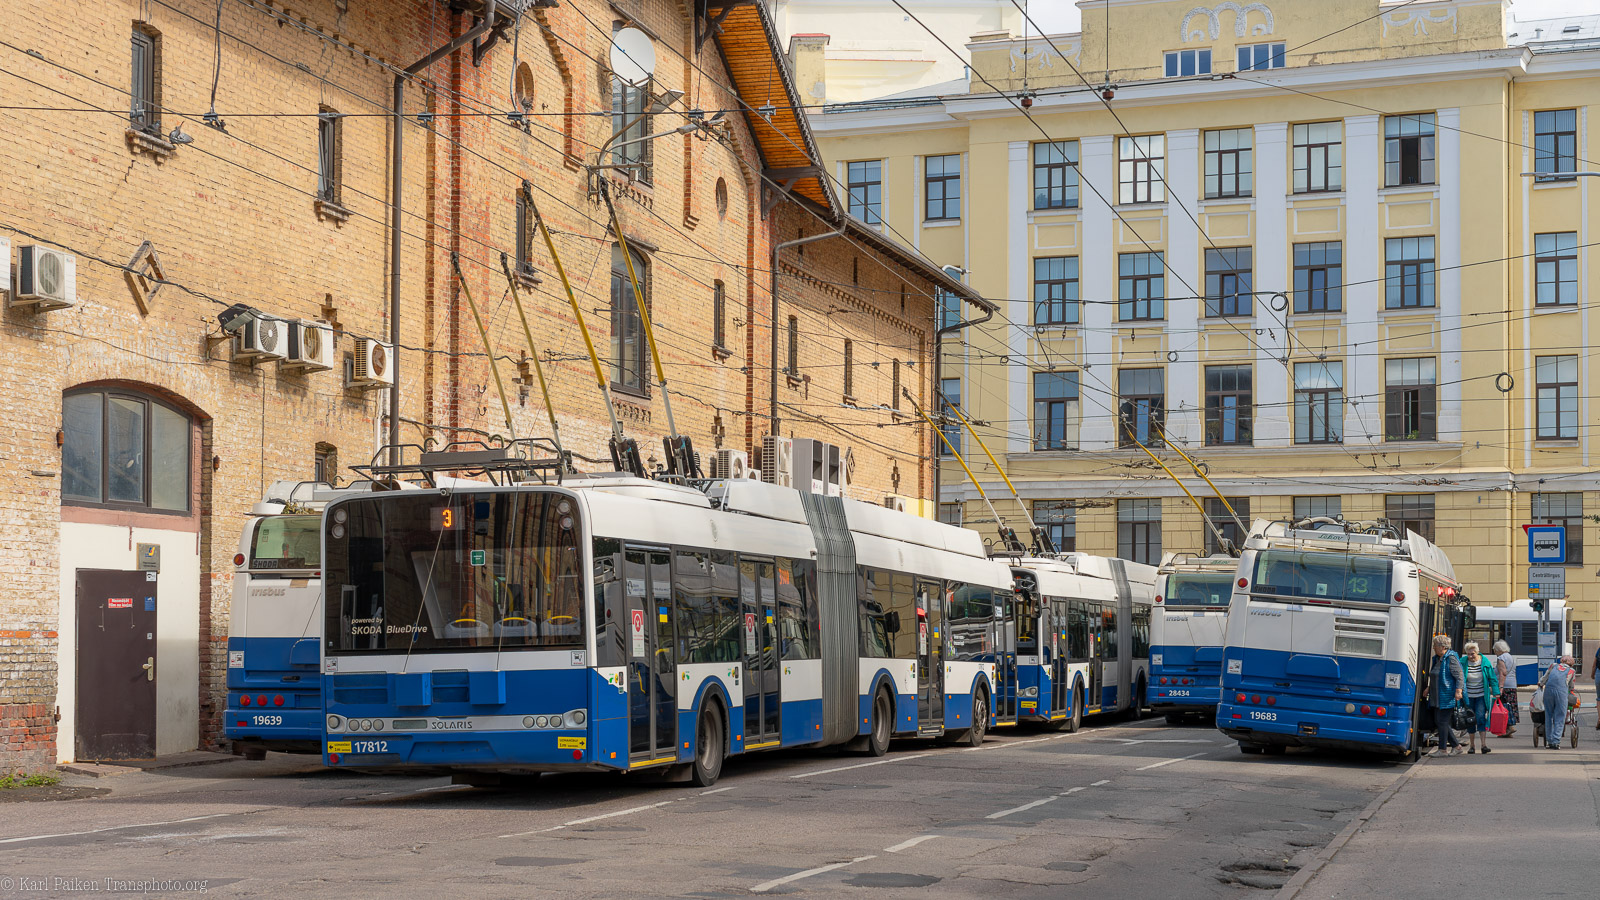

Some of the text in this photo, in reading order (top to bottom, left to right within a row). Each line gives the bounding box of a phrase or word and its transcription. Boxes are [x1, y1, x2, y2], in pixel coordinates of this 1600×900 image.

[442, 509, 452, 528] 3
[1348, 577, 1368, 593] 13
[386, 624, 428, 634] BlueDrive
[252, 715, 283, 726] 19639
[1250, 711, 1277, 721] 19683
[431, 721, 473, 730] SOLARIS
[354, 741, 388, 753] 17812
